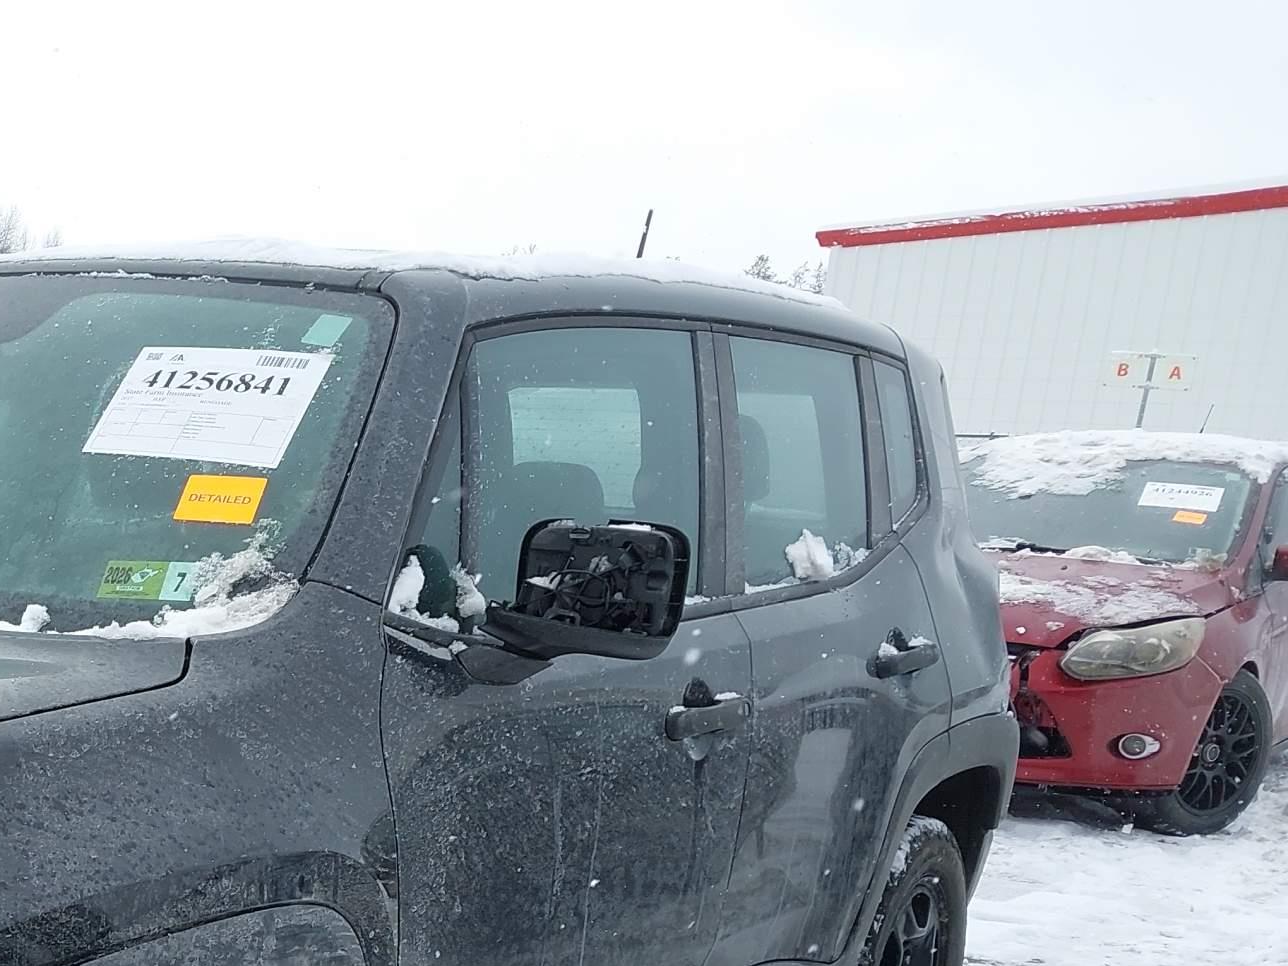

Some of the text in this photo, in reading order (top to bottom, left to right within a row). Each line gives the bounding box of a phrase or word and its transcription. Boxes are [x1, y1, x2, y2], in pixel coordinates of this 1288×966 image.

[1117, 363, 1129, 377] B
[1169, 366, 1181, 380] A
[142, 369, 292, 396] 41256841
[188, 493, 252, 505] DETAILED
[104, 566, 133, 585] 2026
[173, 572, 187, 593] 7
